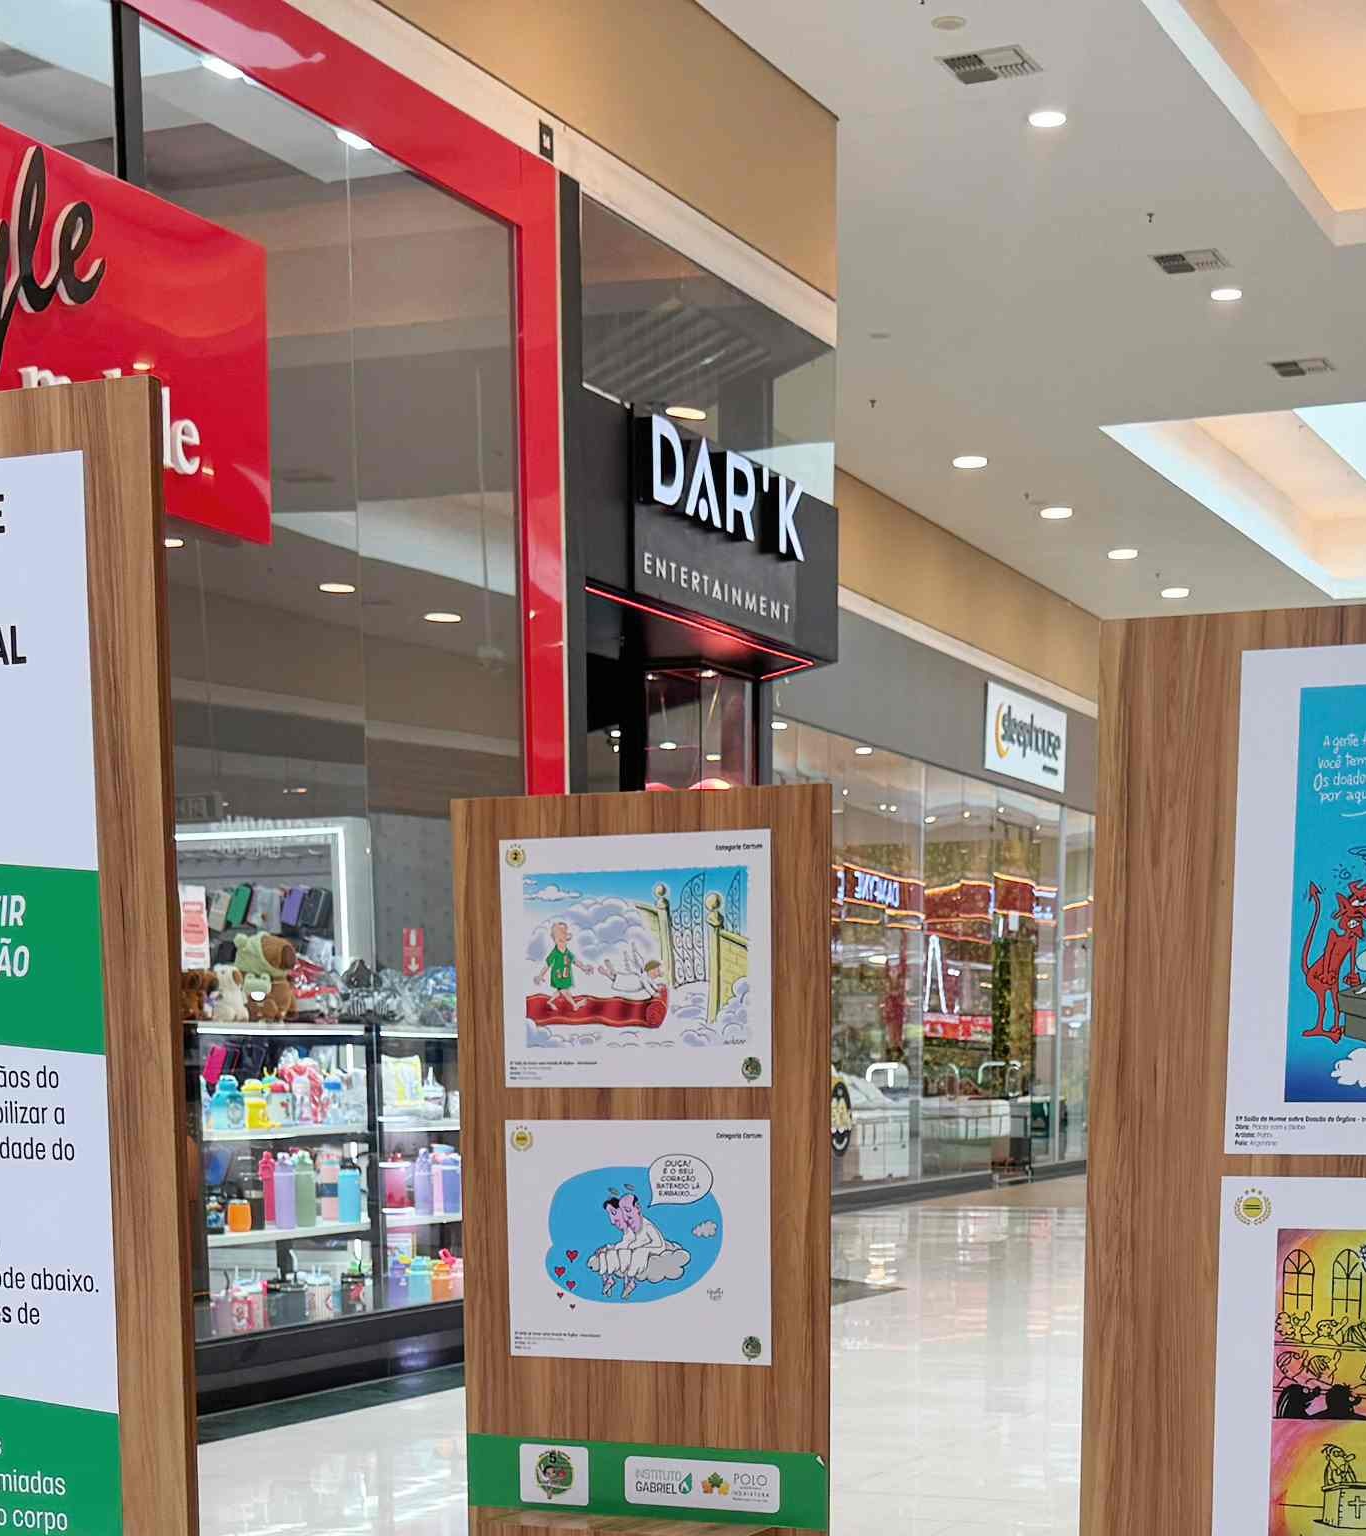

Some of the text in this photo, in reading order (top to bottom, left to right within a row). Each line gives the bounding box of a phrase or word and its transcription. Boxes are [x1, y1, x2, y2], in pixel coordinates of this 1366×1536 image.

[643, 552, 791, 623] ENTERTAINMENT
[36, 1064, 59, 1089] do
[54, 1106, 65, 1125] a
[51, 1137, 75, 1161] do
[31, 1267, 99, 1293] abaixo.
[17, 1301, 40, 1325] de
[635, 1473, 768, 1495] GABRIEL POLO
[12, 1509, 68, 1536] corpo
